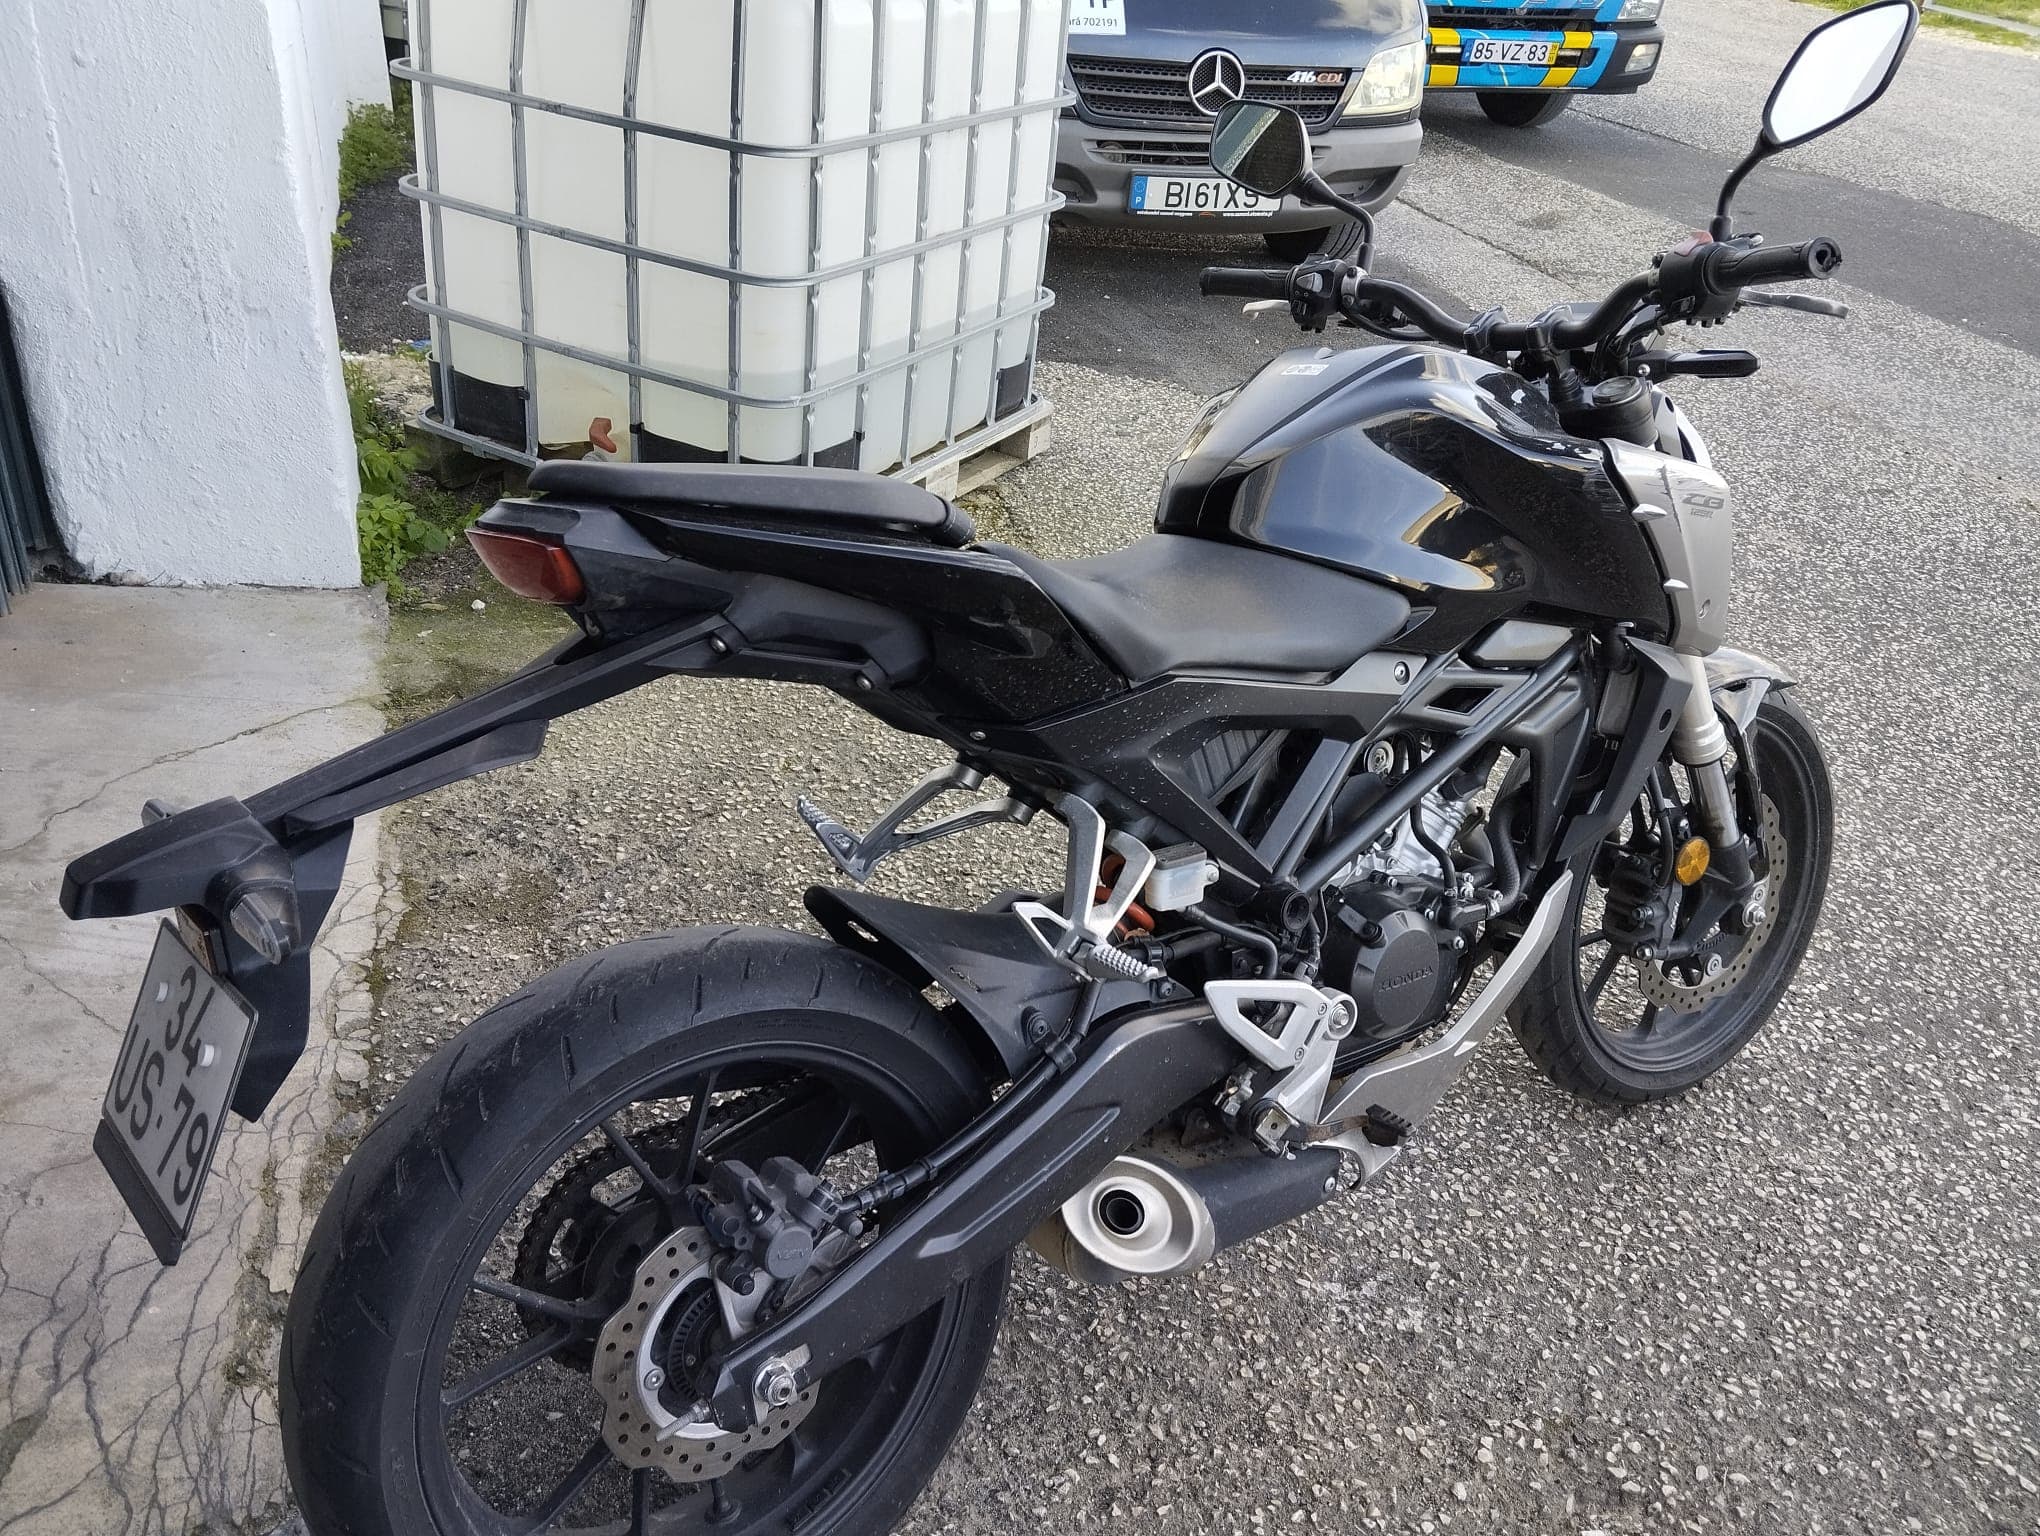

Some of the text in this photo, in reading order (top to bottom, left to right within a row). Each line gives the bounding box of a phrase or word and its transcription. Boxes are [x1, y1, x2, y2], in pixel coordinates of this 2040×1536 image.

[1083, 17, 1118, 27] 702191
[1287, 70, 1343, 83] 416 CDI
[1135, 196, 1142, 204] P
[1379, 965, 1433, 993] HONDA
[165, 965, 215, 1077] 34
